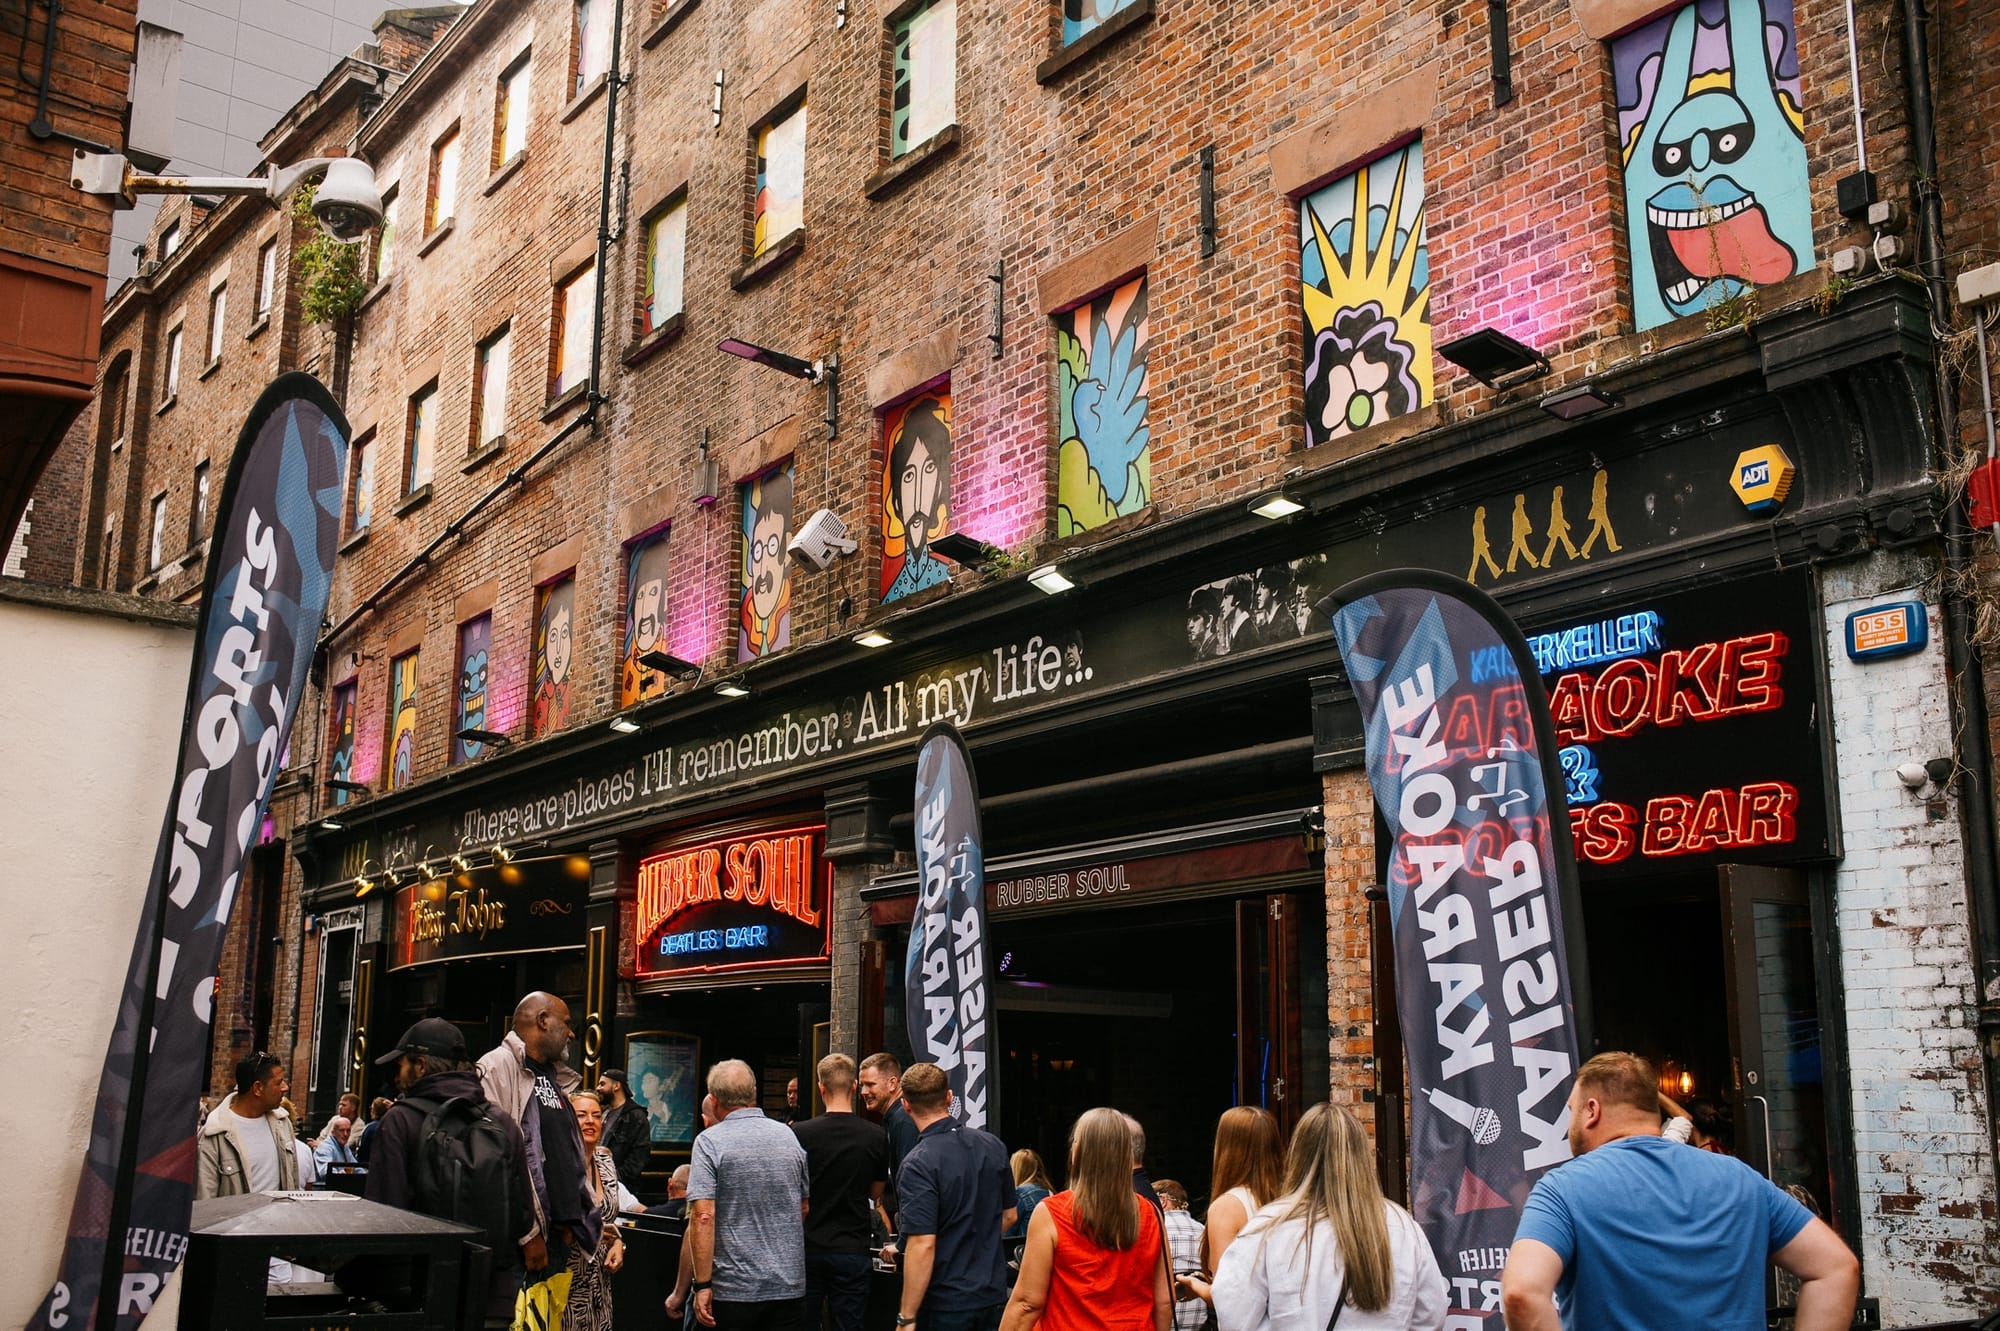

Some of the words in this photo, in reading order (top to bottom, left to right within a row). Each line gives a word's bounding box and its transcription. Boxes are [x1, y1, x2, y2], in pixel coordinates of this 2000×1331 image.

[1742, 463, 1769, 487] ADT
[1859, 614, 1902, 633] OSS
[464, 808, 519, 846] There
[522, 795, 558, 834] are
[561, 767, 635, 830] places
[641, 747, 673, 797] I'll
[679, 713, 843, 786] remember.
[853, 681, 907, 744] All
[917, 667, 983, 729] my
[992, 636, 1095, 703] life...
[1642, 781, 1796, 856] BAR
[636, 848, 722, 945] RUBBER
[724, 834, 821, 928] SOUL
[997, 873, 1070, 907] RUBBER
[1076, 864, 1131, 897] SOUL
[448, 888, 505, 942] John
[660, 929, 718, 955] BEATLES
[725, 925, 768, 948] BAR
